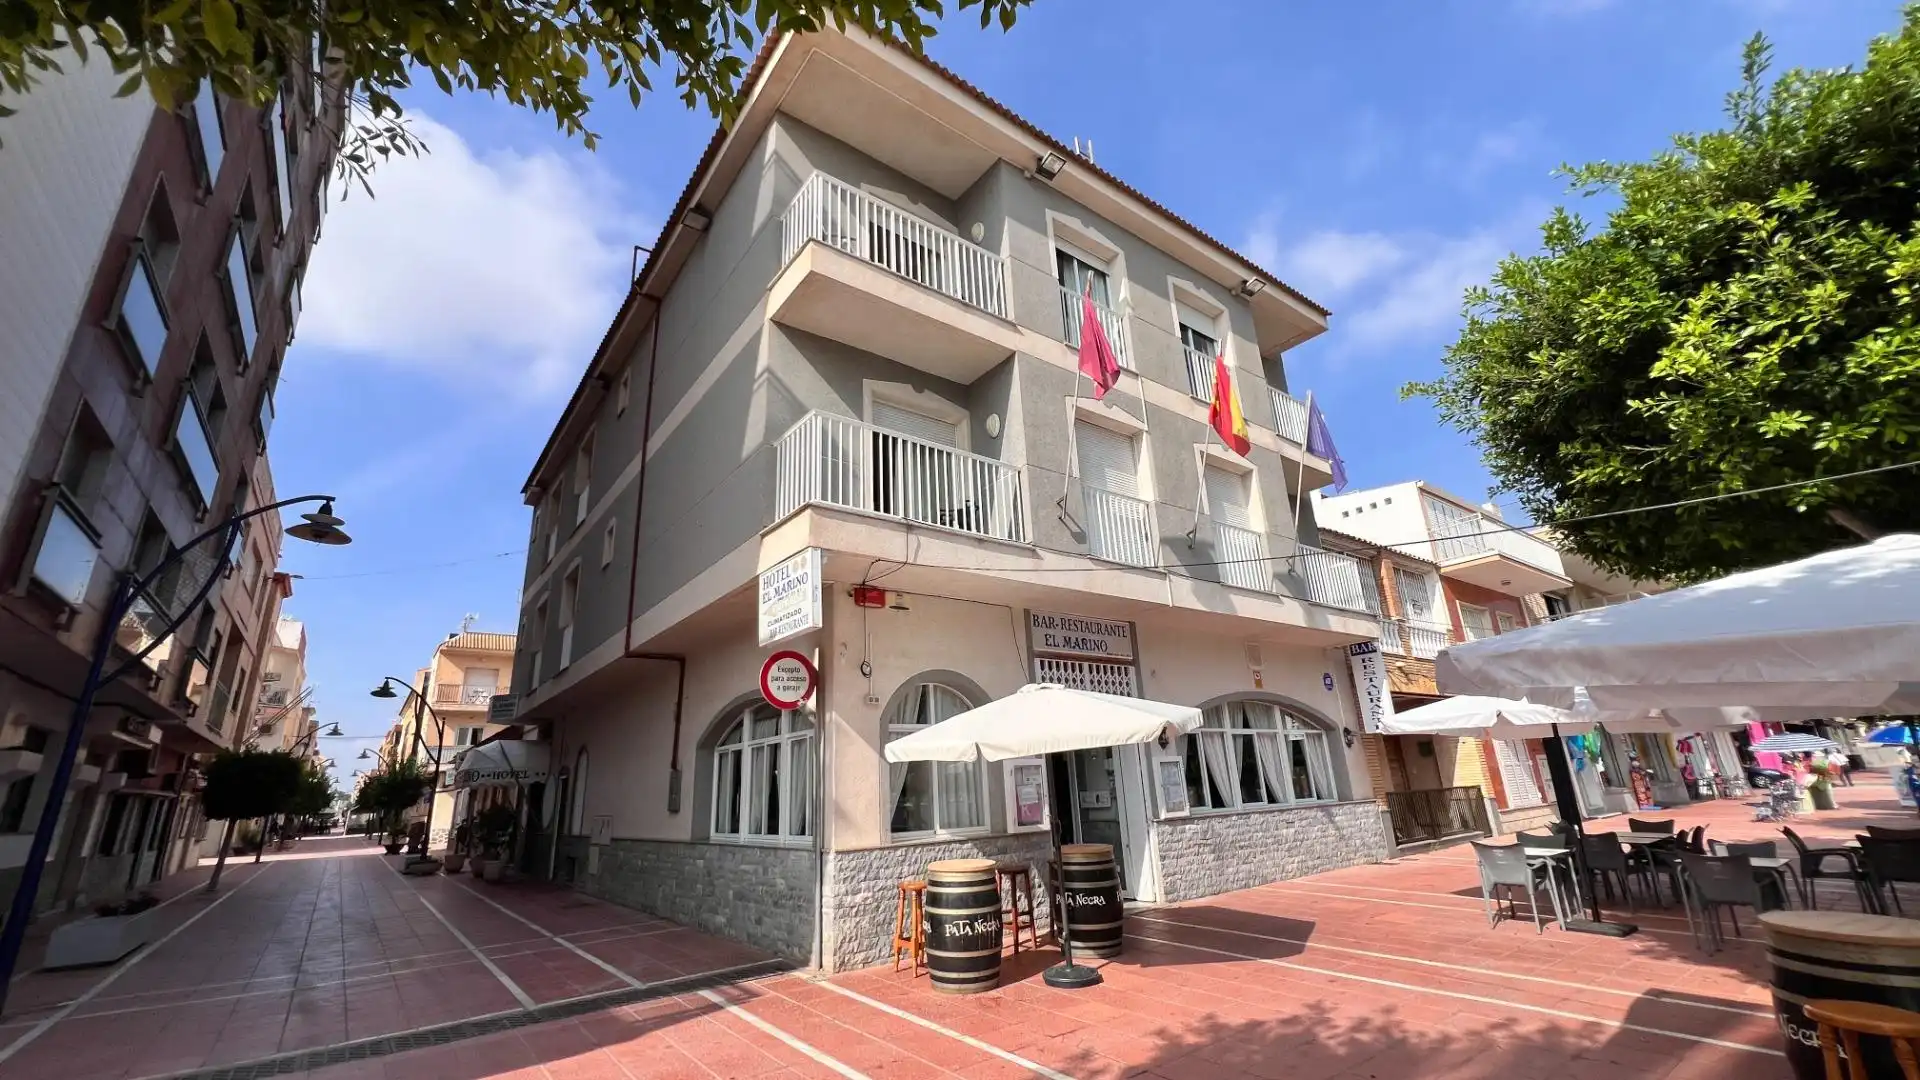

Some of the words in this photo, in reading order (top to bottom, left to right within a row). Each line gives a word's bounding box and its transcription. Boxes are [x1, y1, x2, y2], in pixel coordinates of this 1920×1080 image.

[763, 564, 790, 591] HOTEL
[762, 590, 773, 604] EL
[773, 571, 809, 598] MARINO
[1044, 633, 1060, 648] EL
[1062, 636, 1108, 652] MARINO
[1351, 642, 1377, 654] BAR
[777, 665, 801, 674] Excepto
[492, 767, 529, 780] HOTEL
